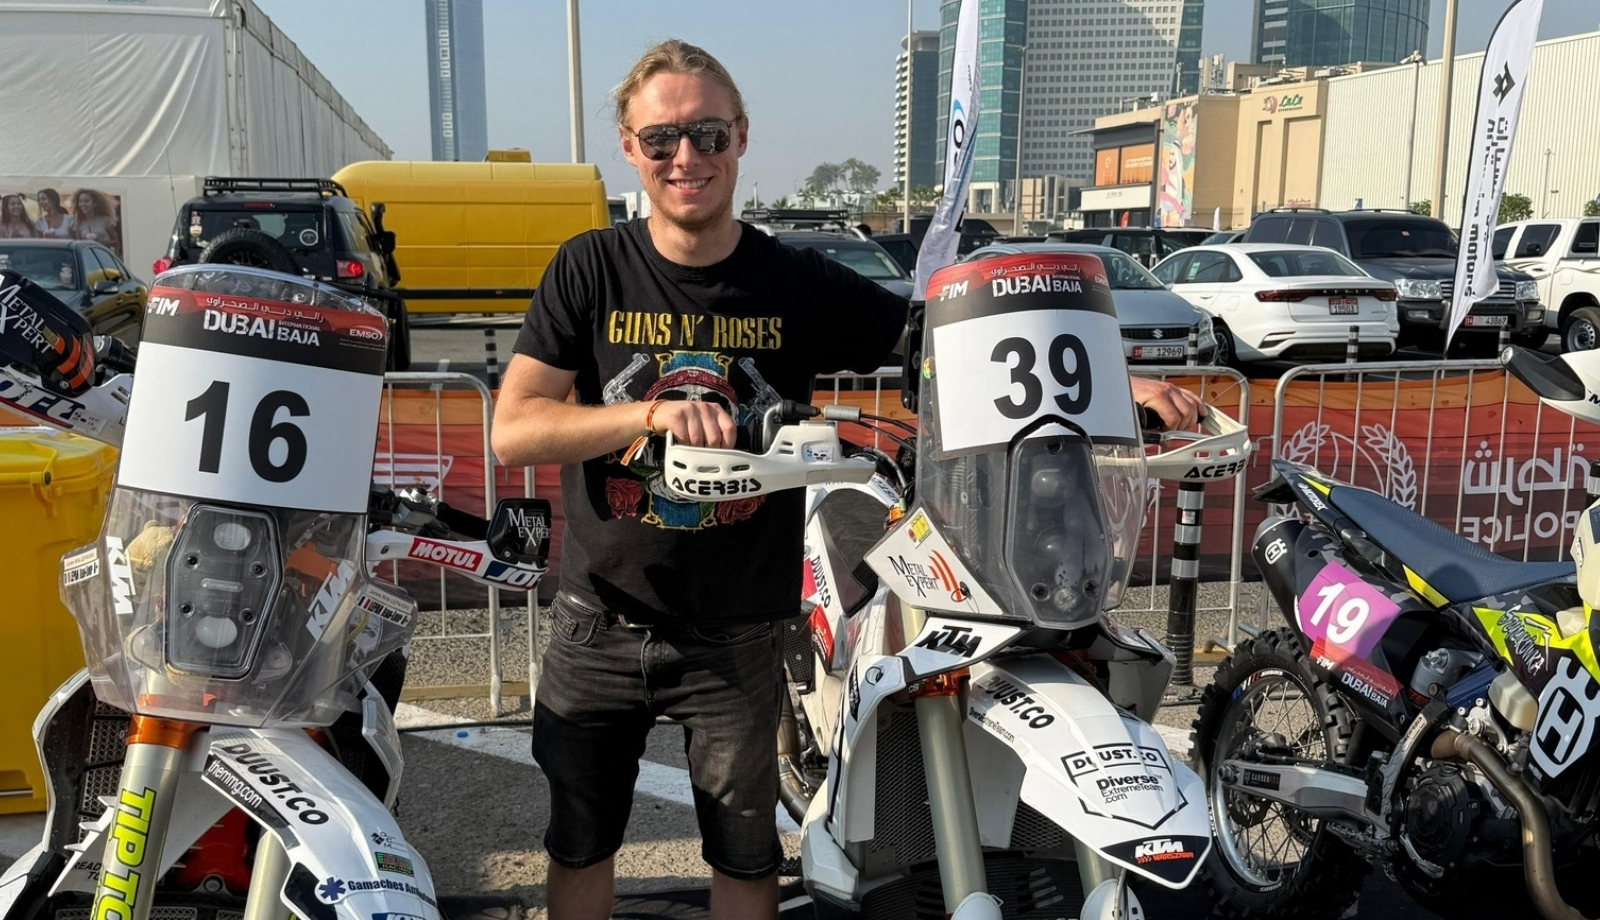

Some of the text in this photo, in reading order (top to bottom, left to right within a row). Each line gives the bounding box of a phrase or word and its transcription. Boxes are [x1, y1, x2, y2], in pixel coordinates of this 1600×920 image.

[940, 280, 968, 302] FIM
[992, 274, 1051, 298] DUBAI
[1052, 280, 1083, 294] BAJA
[147, 297, 179, 317] FIM
[203, 309, 276, 340] DUBAI
[608, 310, 672, 346] GUNS
[711, 315, 783, 350] ROSES
[277, 326, 320, 347] BAJA
[990, 333, 1093, 420] 39
[184, 380, 311, 484] 16
[1184, 458, 1250, 478] ACERB
[672, 477, 762, 496] ACERBIS
[506, 508, 547, 528] METAL
[412, 541, 482, 569] MOTUL
[887, 555, 928, 577] METAL
[106, 536, 136, 614] KTM
[1309, 582, 1370, 644] 19
[914, 625, 982, 659] KTM
[1341, 672, 1374, 698] DUBAI
[1370, 692, 1388, 708] BAJA
[207, 759, 263, 809] themmg.com
[223, 742, 330, 825] DUUST.CO
[1101, 783, 1164, 798] ExtremeTeam
[1104, 793, 1128, 804] .com
[112, 787, 157, 868] TIP
[1135, 838, 1184, 858] KTM
[73, 861, 102, 871] READ
[348, 879, 404, 892] Gamaches
